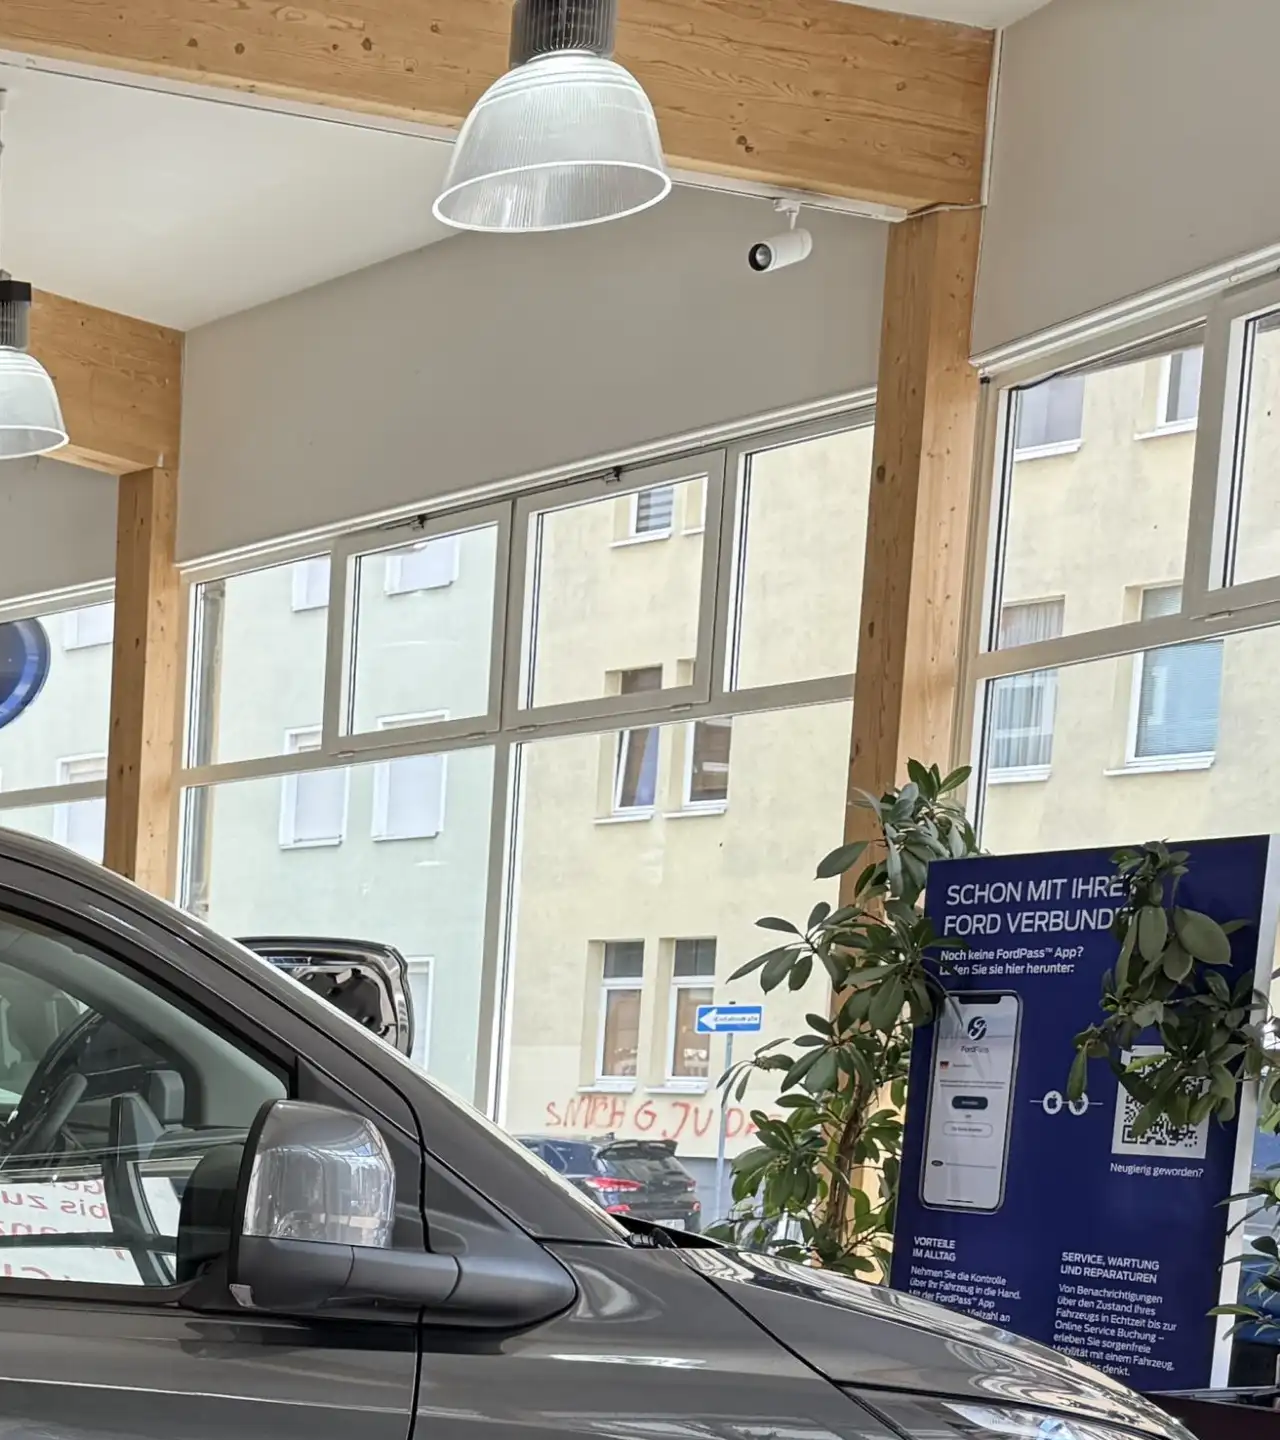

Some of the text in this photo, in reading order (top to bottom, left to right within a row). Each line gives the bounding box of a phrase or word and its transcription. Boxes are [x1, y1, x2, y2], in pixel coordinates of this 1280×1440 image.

[946, 874, 1134, 905] SCHON MIT IHRE
[943, 907, 1133, 936] FORD VERBUND
[941, 950, 967, 961] Noch
[968, 948, 995, 960] keine
[1054, 946, 1084, 960] App?
[971, 964, 987, 975] Sie
[989, 964, 1004, 975] sie
[1005, 963, 1025, 974] hier
[1026, 963, 1075, 975] herunter:
[1110, 1163, 1204, 1178] Neugierig geworden?
[913, 1236, 956, 1249] VORTEILE
[912, 1248, 956, 1262] IM ALLTAG
[1062, 1251, 1159, 1271] SERVICE, WARTUNG
[911, 1266, 1007, 1286] Nehmen Sie die Kontrolle
[1060, 1265, 1157, 1283] UND REPARATUREN
[939, 1281, 974, 1295] Fahrzeug
[976, 1285, 983, 1295] in
[984, 1287, 997, 1296] die
[997, 1289, 1021, 1300] Hand.
[1059, 1284, 1163, 1304] Von Benachrichtigungen
[978, 1299, 995, 1309] App
[1057, 1296, 1156, 1316] über den Zustand Ihres
[999, 1313, 1010, 1322] an
[1056, 1308, 1177, 1331] Fahrzeugs in Echtzeit bis zur
[1055, 1320, 1082, 1332] Online
[1084, 1323, 1116, 1336] Service
[1117, 1328, 1156, 1342] Buchung
[1053, 1333, 1151, 1354] erleben Sie sorgenfreie
[1090, 1351, 1103, 1360] mit
[1105, 1353, 1132, 1363] einem
[1133, 1355, 1175, 1371] Fahrzeug,
[1102, 1364, 1130, 1376] denkt.
